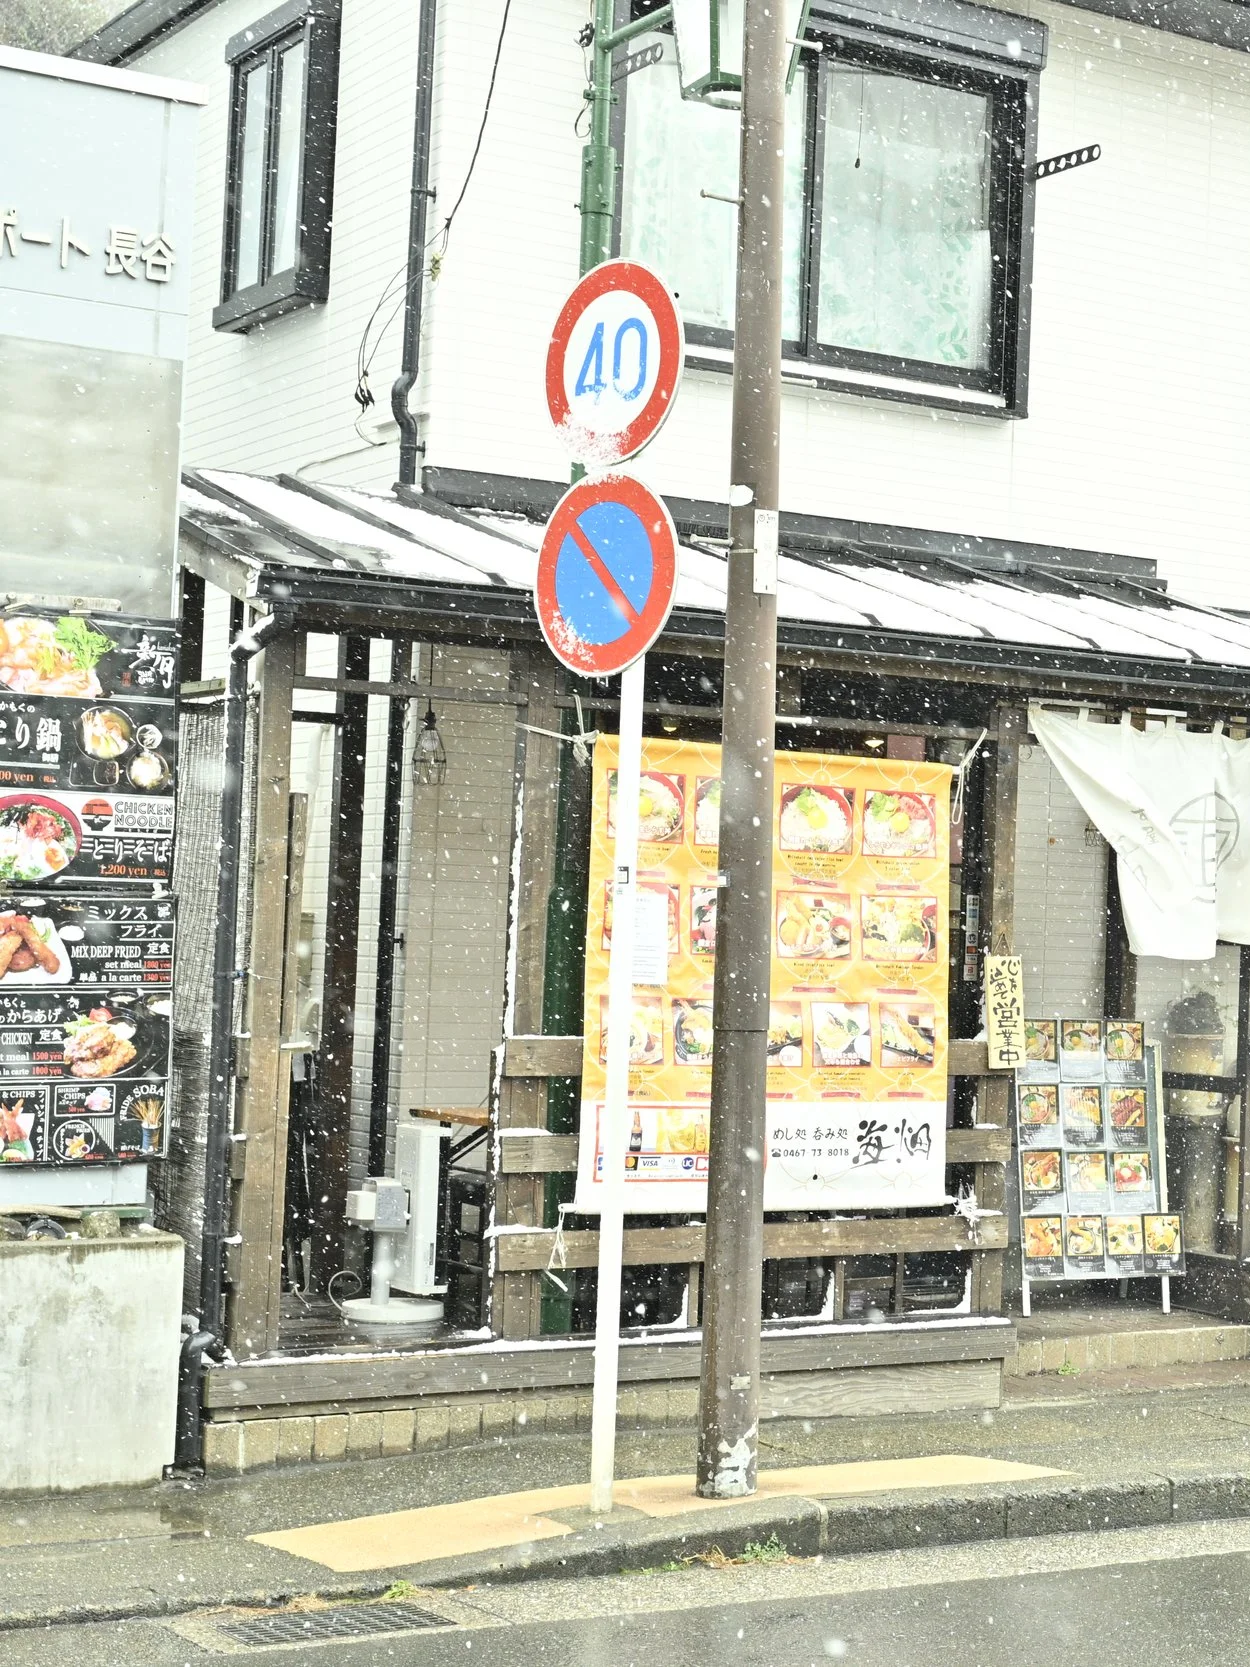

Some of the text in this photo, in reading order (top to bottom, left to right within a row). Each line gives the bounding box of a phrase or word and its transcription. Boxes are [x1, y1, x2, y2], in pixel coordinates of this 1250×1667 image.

[105, 224, 177, 283] 長谷
[575, 317, 648, 402] 40
[13, 774, 34, 784] yen
[115, 801, 173, 816] CHICKEN
[115, 815, 173, 828] NOODLE
[93, 838, 172, 863] とりそば
[100, 864, 126, 875] 1,200
[128, 867, 147, 876] yen
[88, 905, 148, 920] ミックス
[121, 924, 162, 937] フライ
[71, 945, 141, 959] MIX DEEP FRIED
[147, 942, 170, 954] 定食
[105, 960, 119, 969] set
[120, 960, 143, 969] meal
[108, 973, 118, 981] la
[119, 973, 143, 981] carte
[1, 1029, 63, 1045] CHICKEN 定食
[993, 997, 1023, 1066] 営業中
[6, 1052, 30, 1061] meal
[32, 1052, 49, 1060] 1500
[11, 1068, 30, 1076] carte
[49, 1067, 62, 1076] yen
[2, 1091, 9, 1099] &
[133, 1084, 165, 1098] SOBA
[772, 1127, 848, 1141] めし処 呑み処
[642, 1159, 659, 1167] VISA
